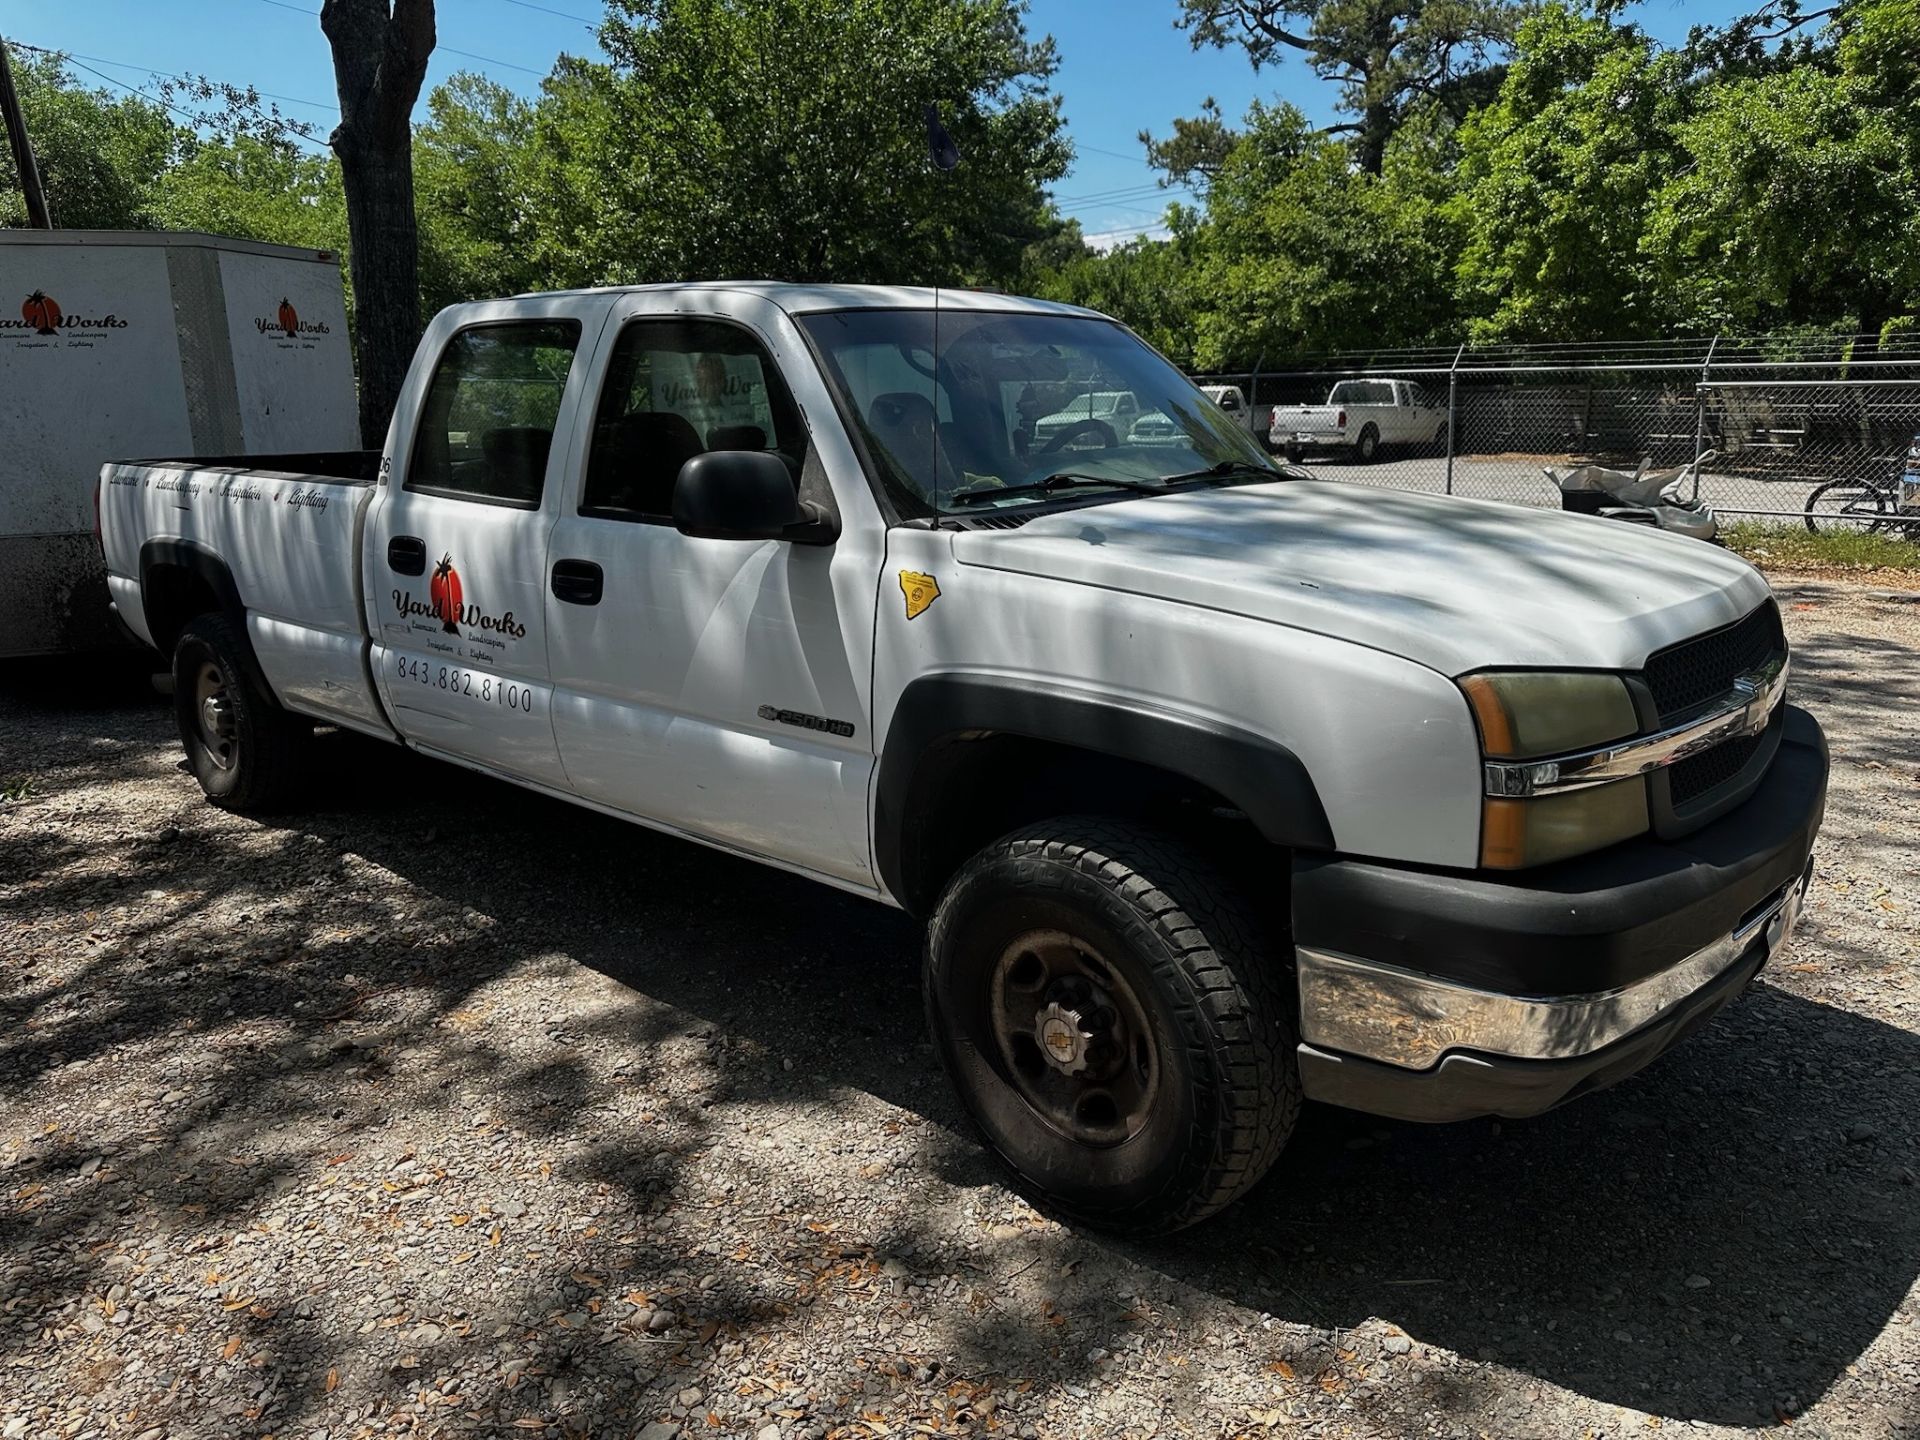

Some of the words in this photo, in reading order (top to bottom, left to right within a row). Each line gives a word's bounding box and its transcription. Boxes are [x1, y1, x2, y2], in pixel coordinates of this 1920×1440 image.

[0, 317, 38, 329] ard
[55, 314, 128, 329] Works
[255, 318, 288, 334] Yard
[295, 321, 330, 334] Works
[287, 487, 329, 515] Lighting
[392, 589, 444, 619] Yard
[457, 603, 526, 638] Works
[398, 656, 531, 713] 843.882.8100
